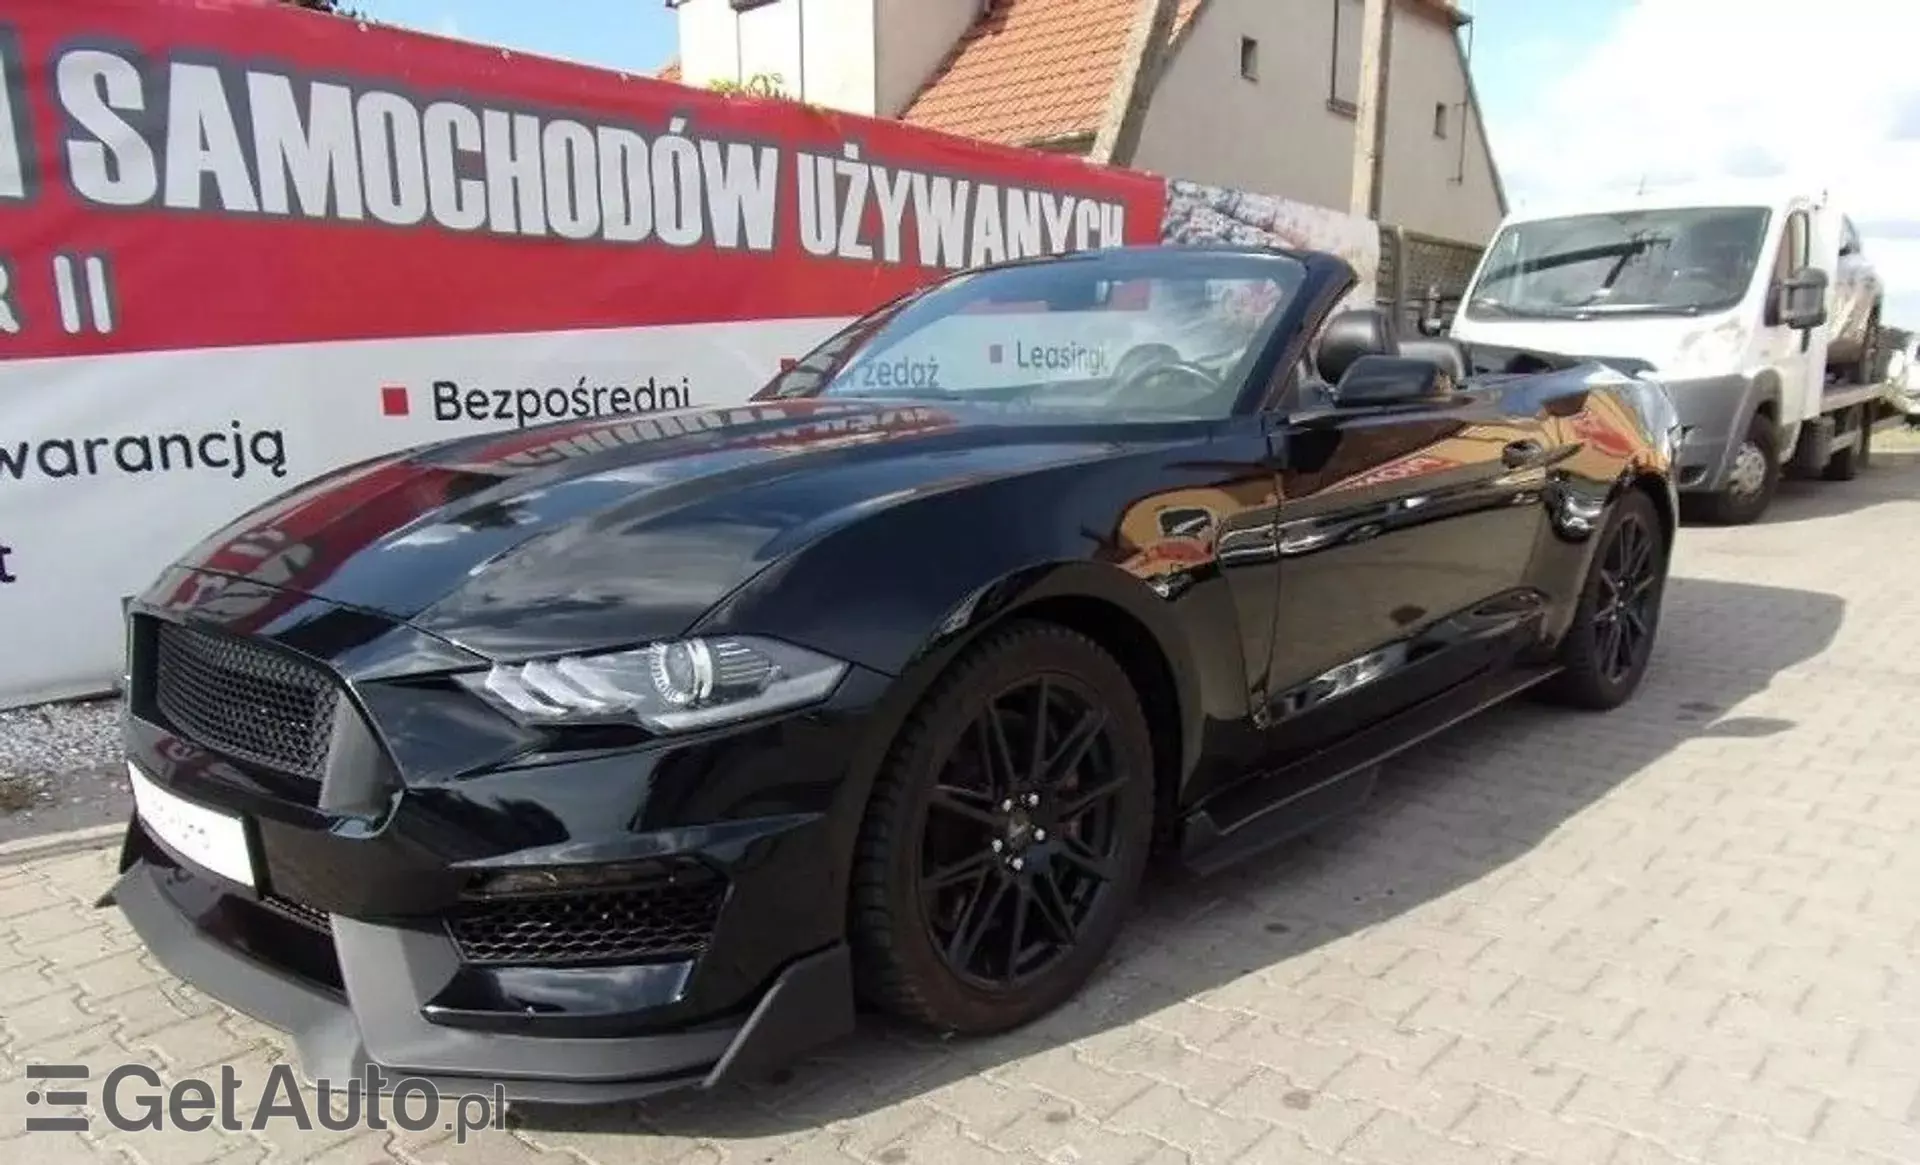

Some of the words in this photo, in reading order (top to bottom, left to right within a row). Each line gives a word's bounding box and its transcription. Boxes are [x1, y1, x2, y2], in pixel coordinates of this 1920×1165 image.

[56, 49, 778, 251] SAMOCHODÓW
[797, 142, 1124, 268] UŻYWANYCH
[432, 376, 690, 428] Bezpośredni
